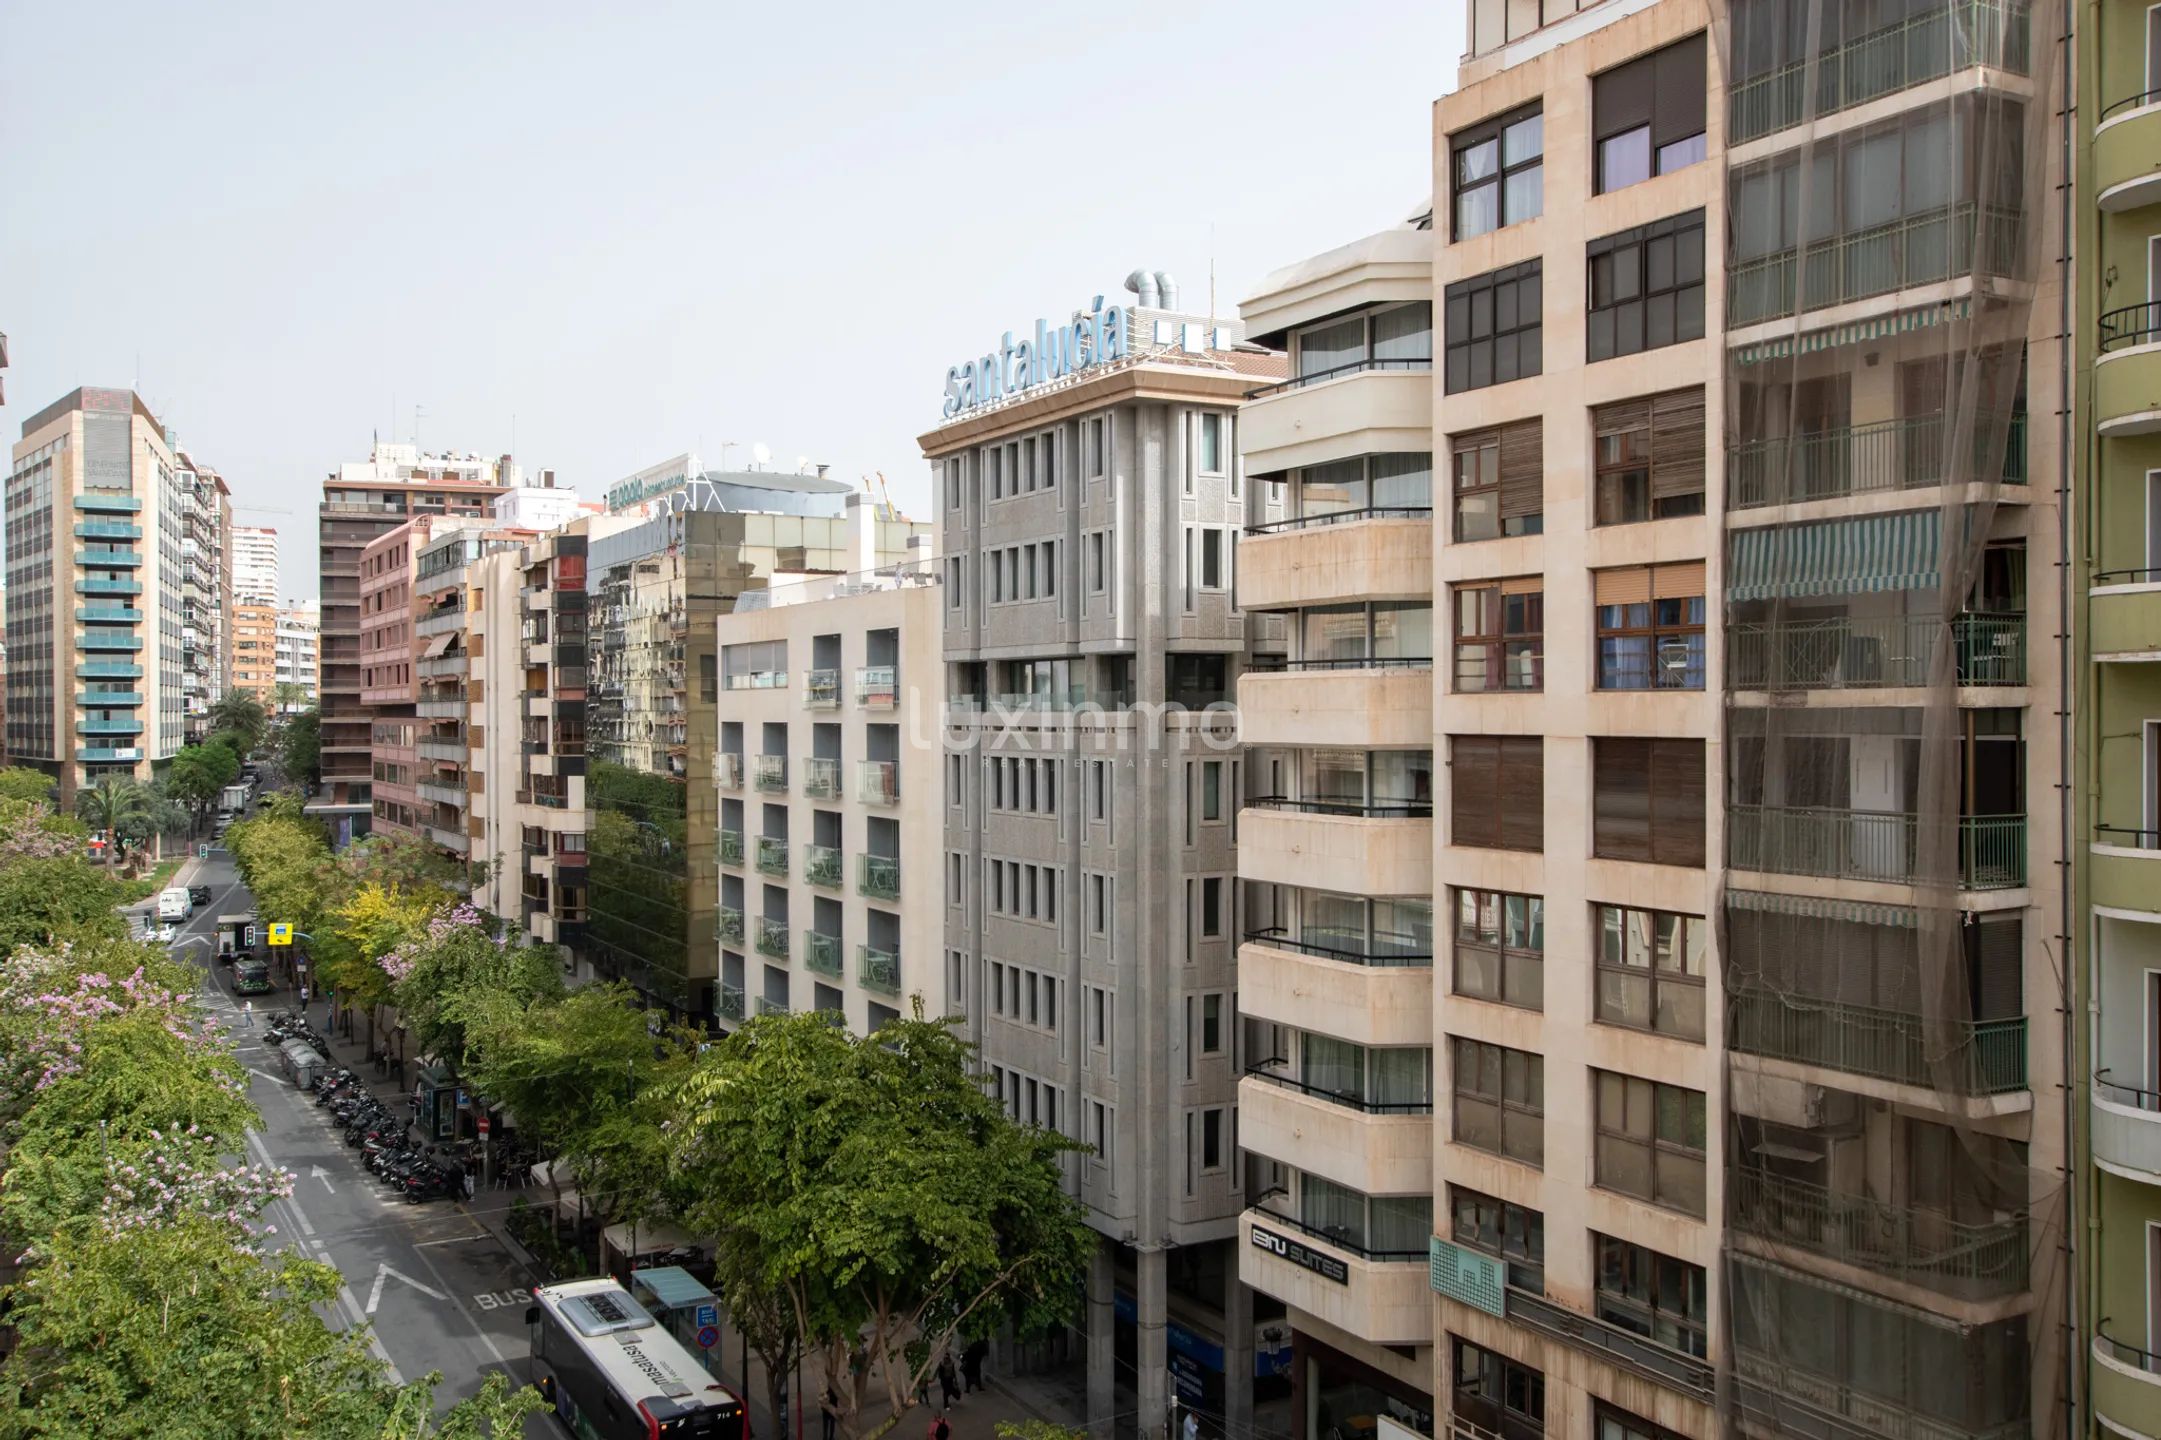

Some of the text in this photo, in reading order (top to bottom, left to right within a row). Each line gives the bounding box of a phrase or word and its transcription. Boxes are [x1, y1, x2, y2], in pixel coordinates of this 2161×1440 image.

[944, 295, 1125, 417] santalucía
[1290, 1244, 1344, 1280] SUITES
[473, 1288, 533, 1310] BUS
